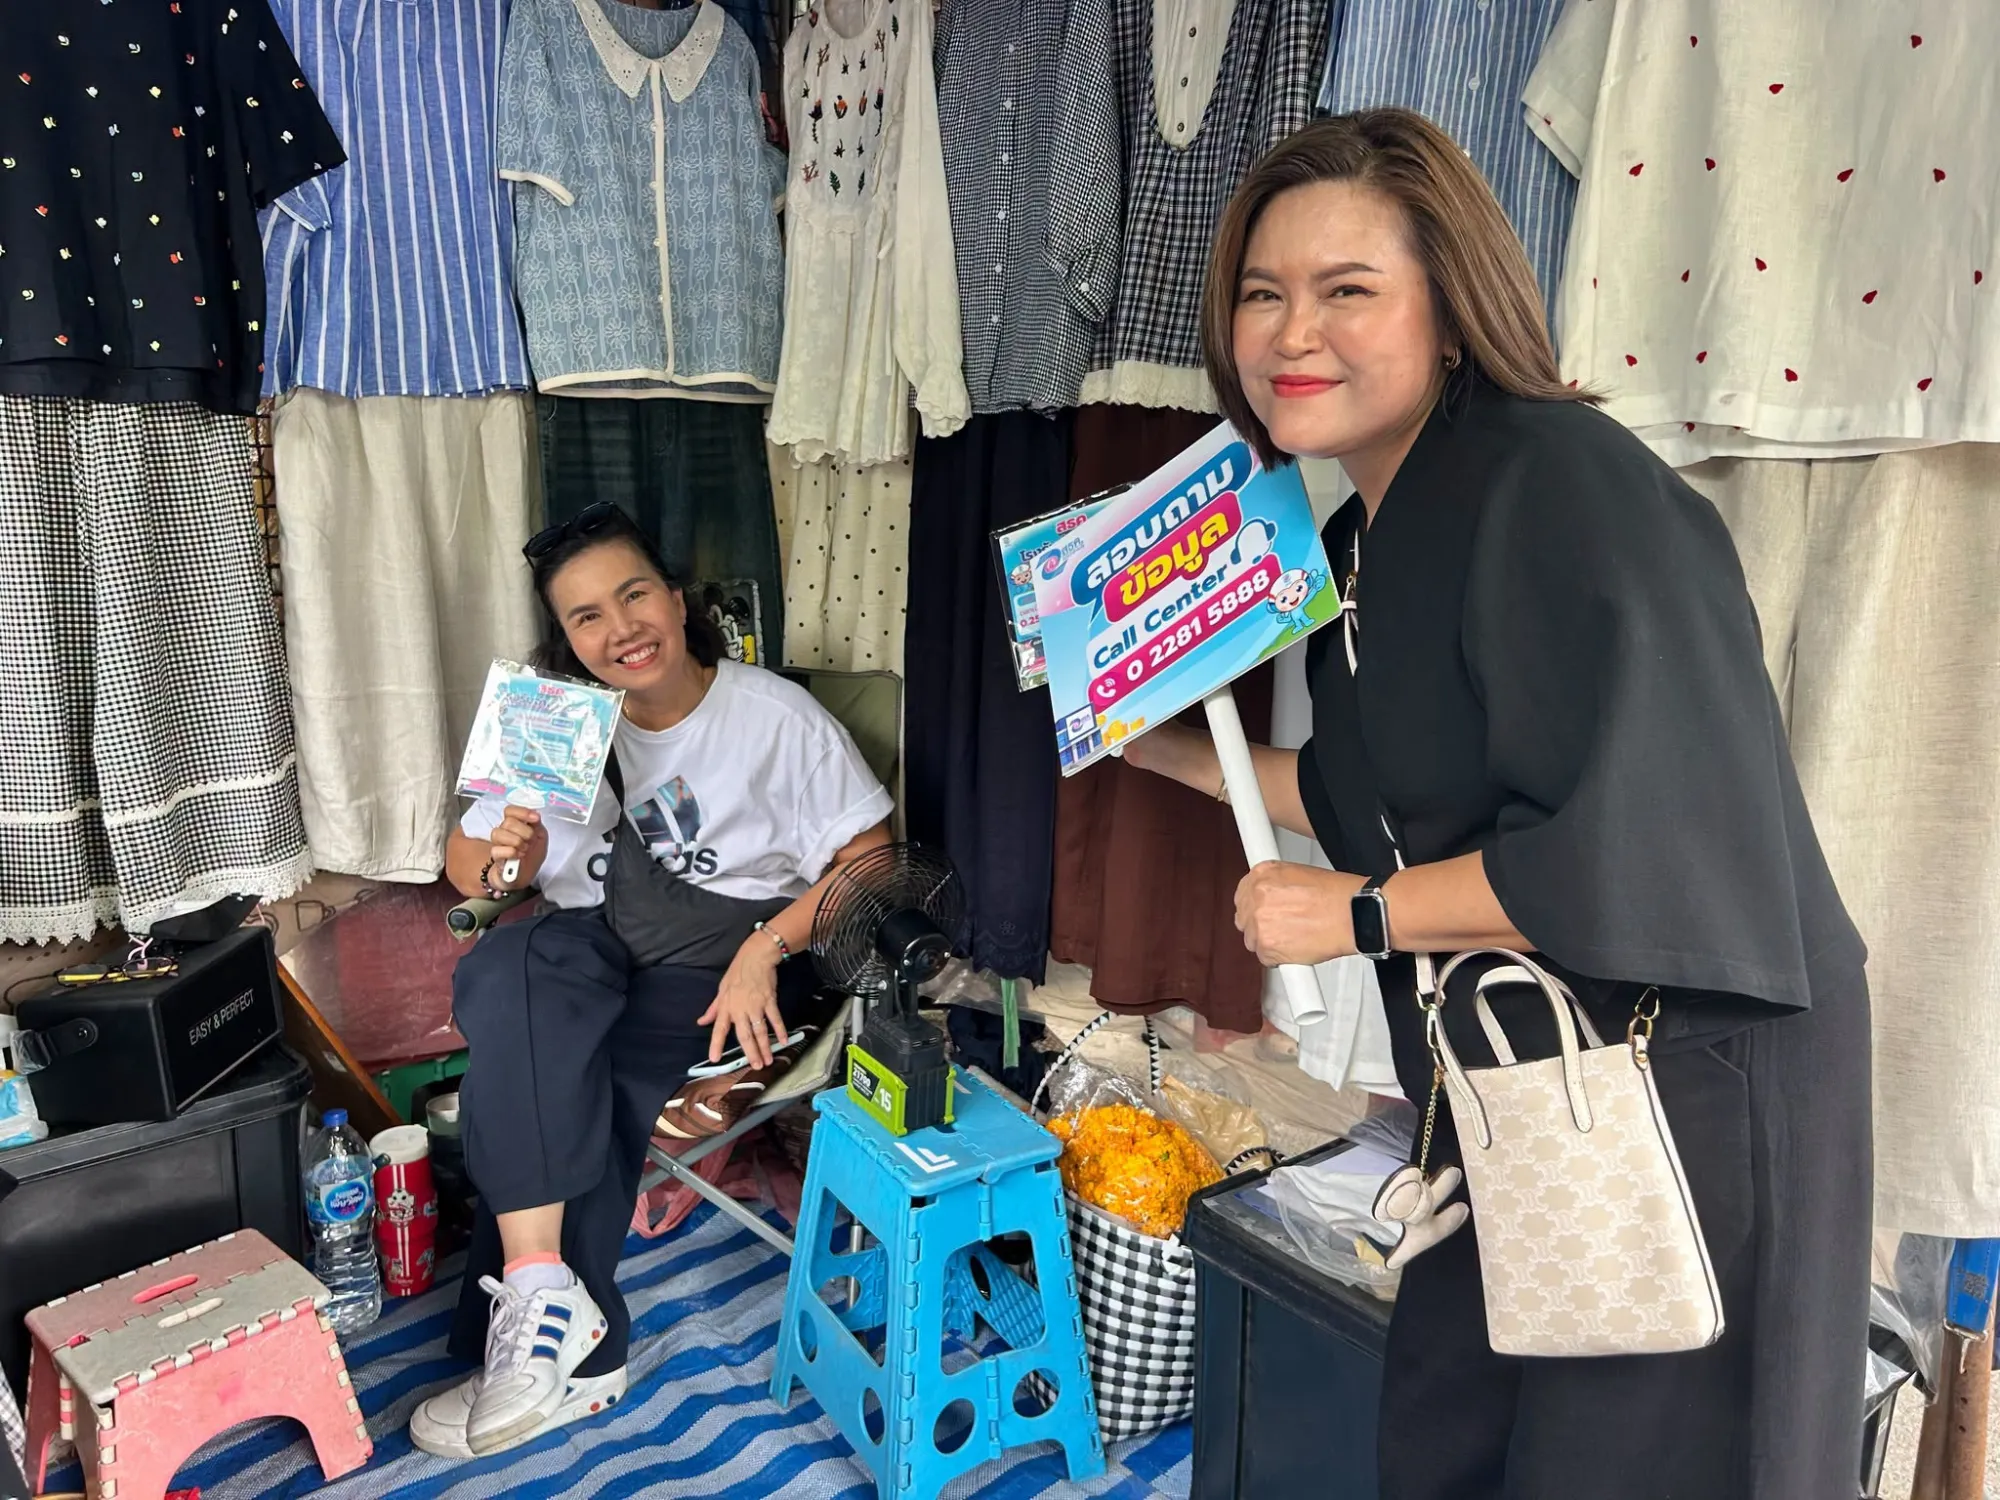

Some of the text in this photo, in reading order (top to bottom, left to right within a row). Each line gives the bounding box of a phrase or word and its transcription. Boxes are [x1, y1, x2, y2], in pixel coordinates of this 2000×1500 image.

[1087, 458, 1234, 589] สอบถาม
[1120, 512, 1229, 605] ข้อมูล
[1094, 564, 1228, 669] Call Center
[1127, 569, 1270, 681] 0 2281 5888
[189, 988, 254, 1046] EASY & PERFECT
[880, 1088, 892, 1112] 15
